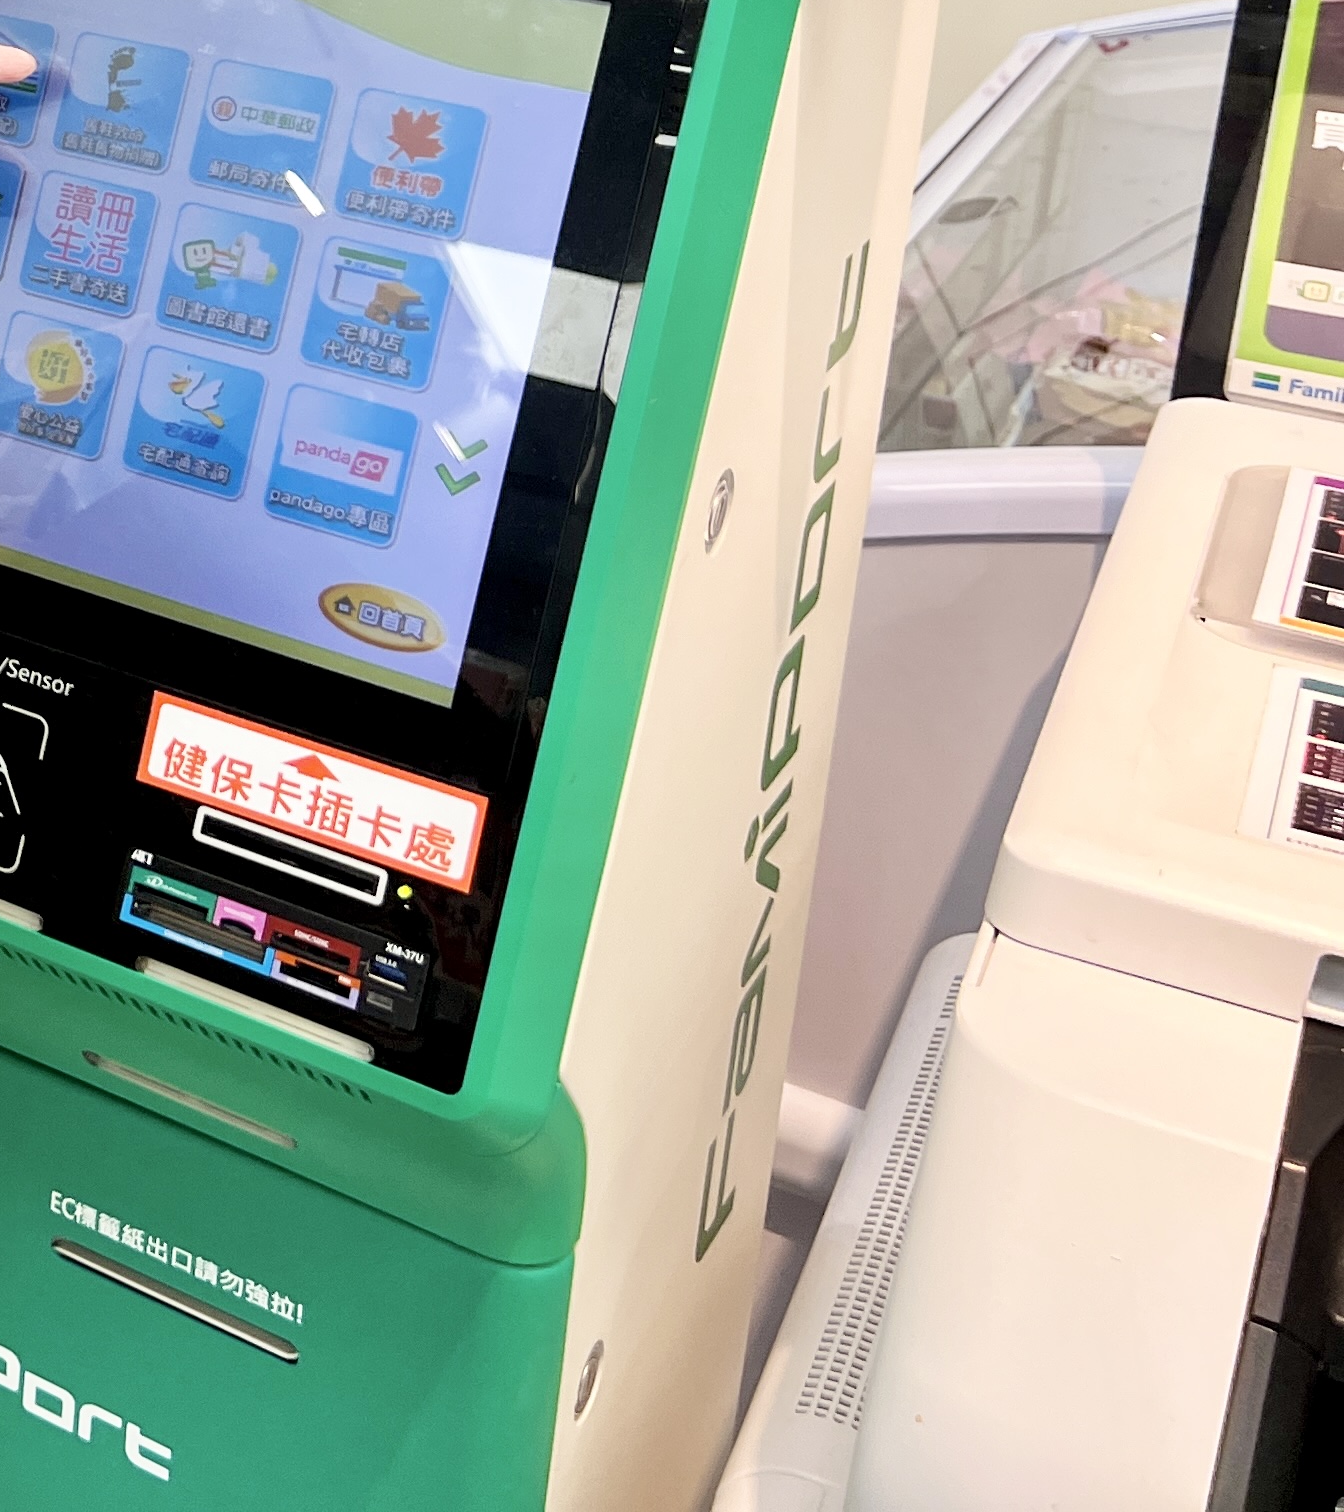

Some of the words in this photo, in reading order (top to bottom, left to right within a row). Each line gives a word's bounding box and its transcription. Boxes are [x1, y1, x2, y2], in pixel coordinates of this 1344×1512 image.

[207, 159, 291, 194] 郵局寄件
[372, 165, 444, 198] 便利帶
[56, 182, 135, 236] 讀冊
[344, 190, 456, 232] 便利帶寄件
[45, 223, 130, 275] 生活
[29, 262, 129, 306] 二手書寄送
[164, 295, 272, 341] 圖書館還書
[336, 319, 406, 355] 宅轉店
[321, 340, 412, 381] 代收包裹
[138, 441, 232, 485] 宅配通查詢
[359, 601, 426, 641] 回首頁
[693, 239, 871, 1264] FamiPort
[162, 737, 459, 875] 健保卡插卡處
